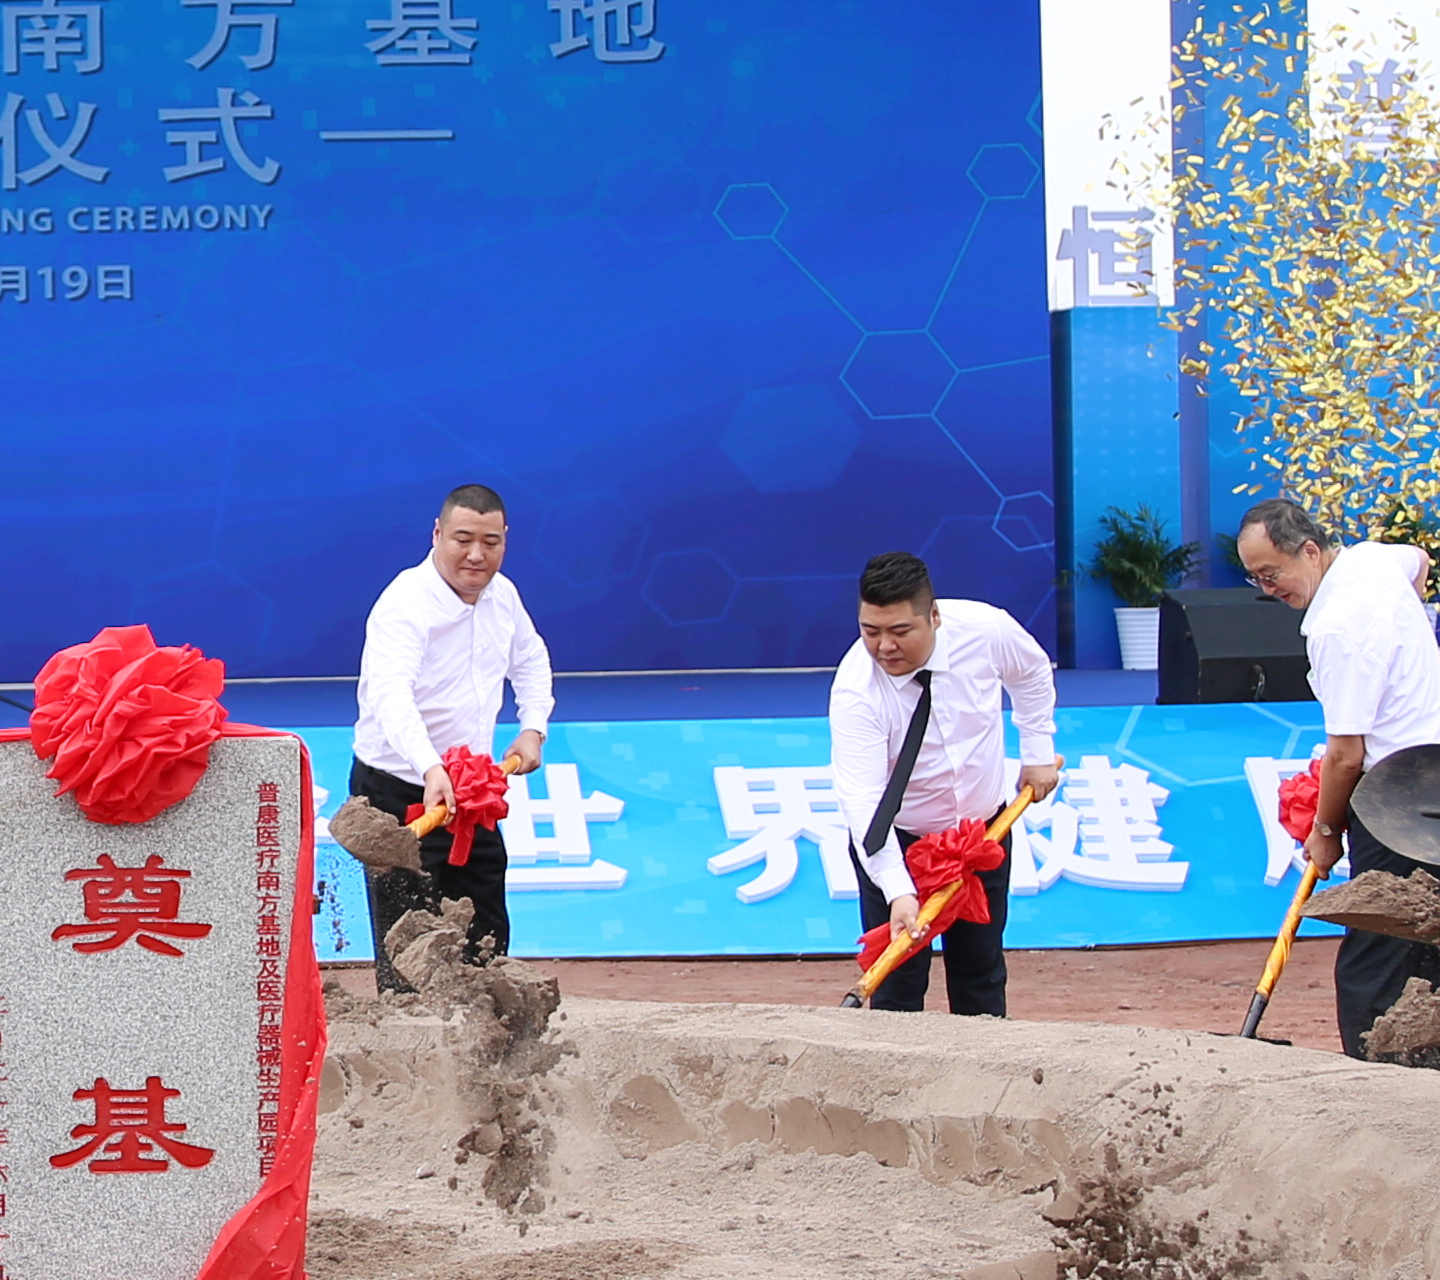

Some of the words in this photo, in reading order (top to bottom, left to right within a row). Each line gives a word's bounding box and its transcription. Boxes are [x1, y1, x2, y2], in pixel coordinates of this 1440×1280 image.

[67, 204, 273, 232] CEREMONY
[1056, 205, 1153, 306] 恒
[49, 853, 214, 1173] 奠基
